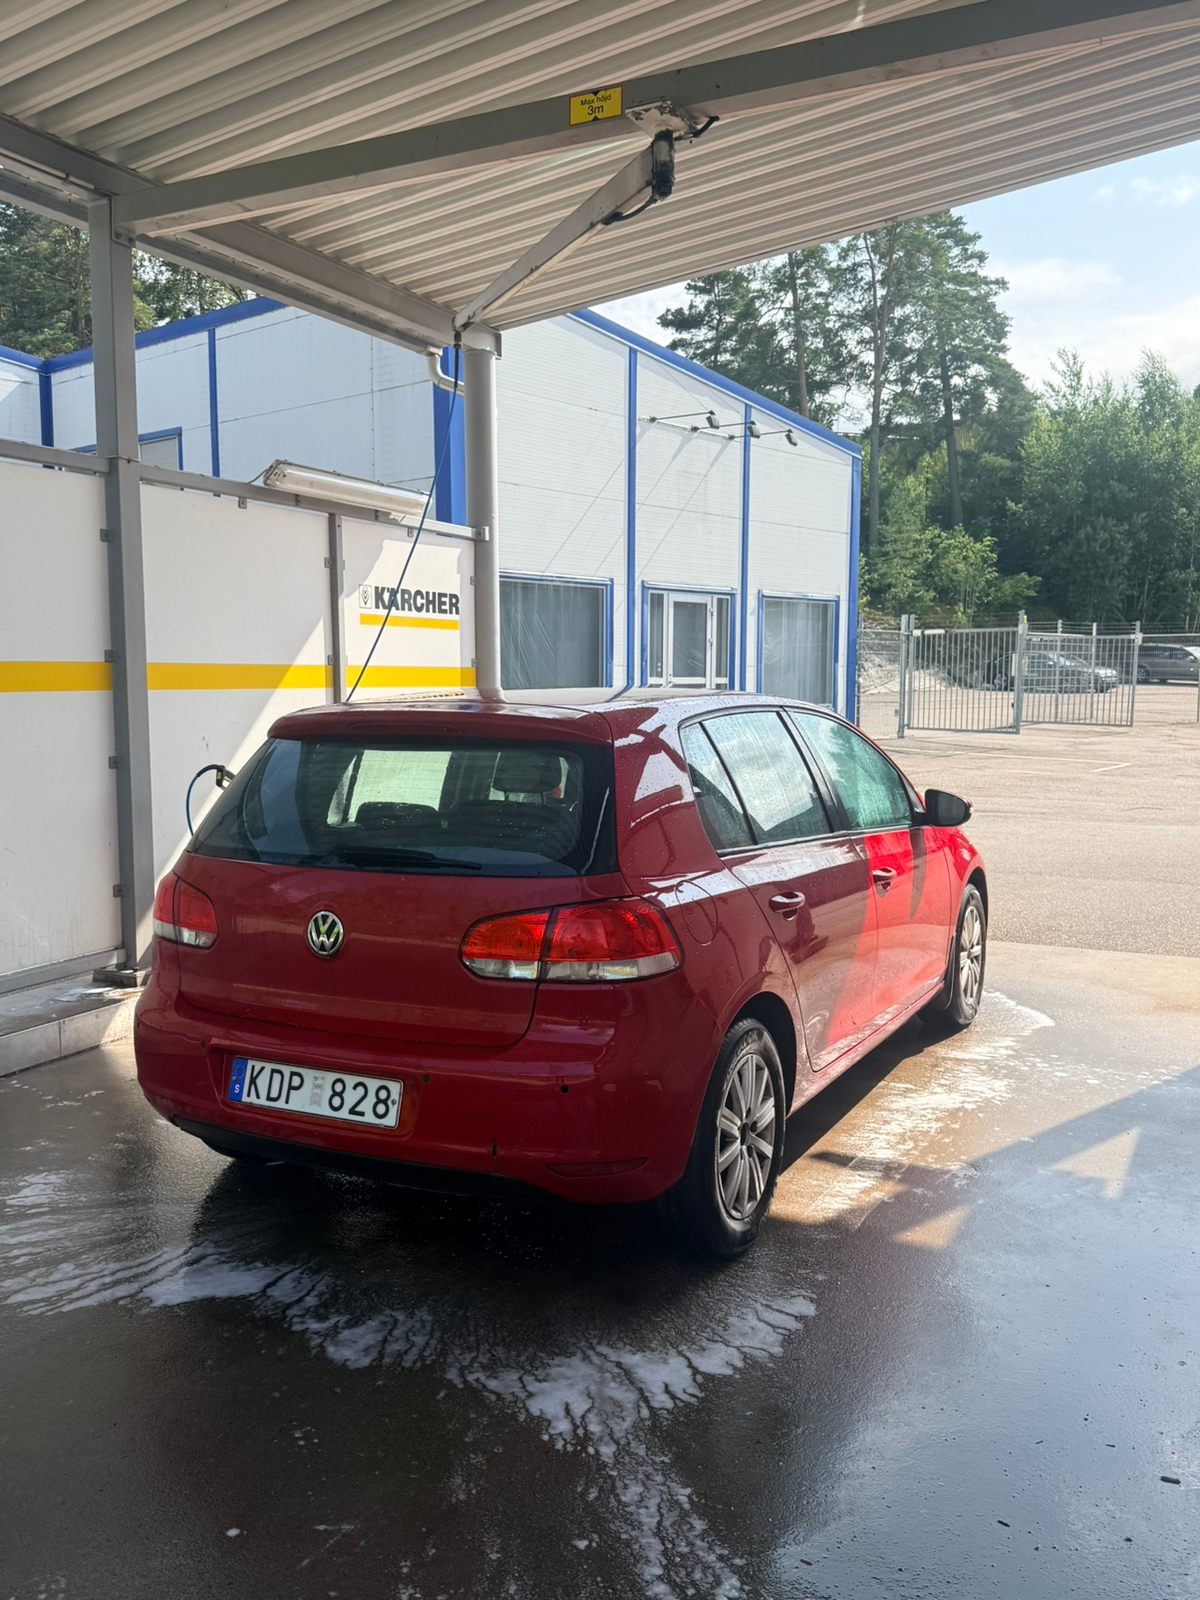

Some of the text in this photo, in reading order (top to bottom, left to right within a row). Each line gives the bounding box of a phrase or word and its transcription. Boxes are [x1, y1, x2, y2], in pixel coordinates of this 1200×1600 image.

[580, 94, 612, 106] Max höjd
[587, 105, 604, 116] 3m
[374, 586, 460, 615] KÄRCHER
[309, 911, 343, 954] VW
[234, 1084, 241, 1094] S
[246, 1064, 391, 1120] KDP 828
